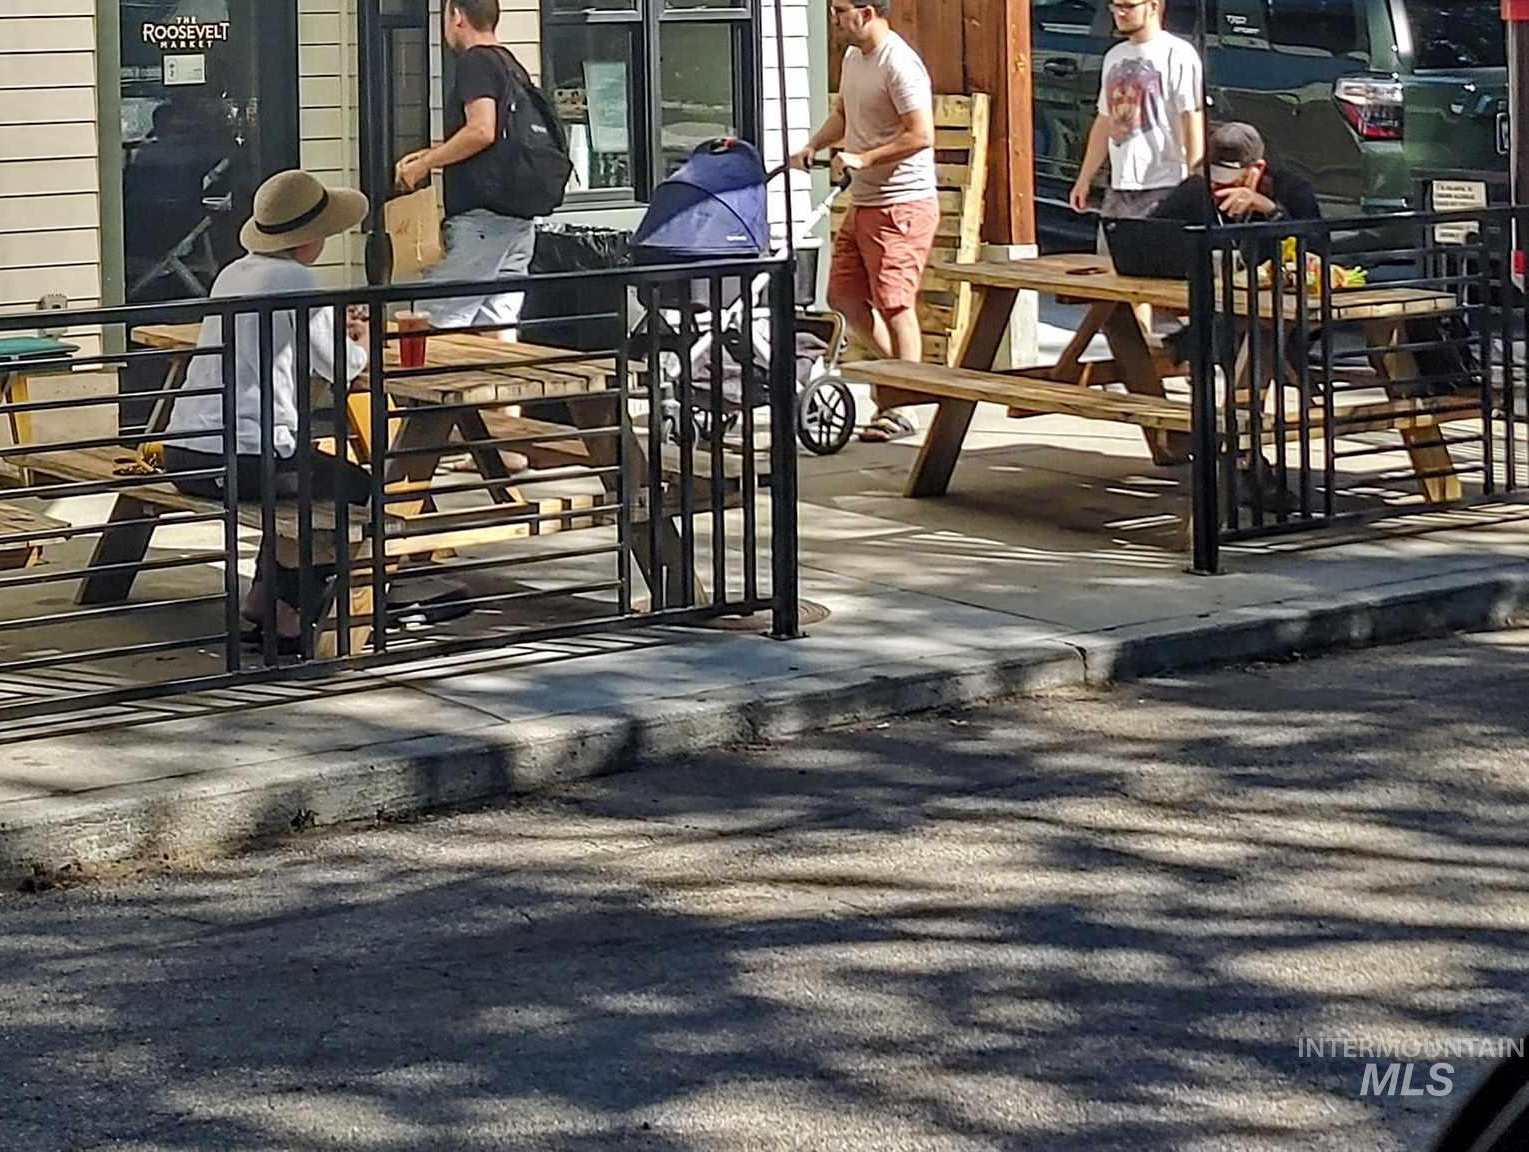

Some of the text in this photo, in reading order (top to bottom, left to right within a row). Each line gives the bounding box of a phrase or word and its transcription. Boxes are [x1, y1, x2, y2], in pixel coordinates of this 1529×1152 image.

[176, 16, 197, 25] THE
[142, 22, 230, 43] ROOSEVELT
[159, 40, 213, 49] MARKET
